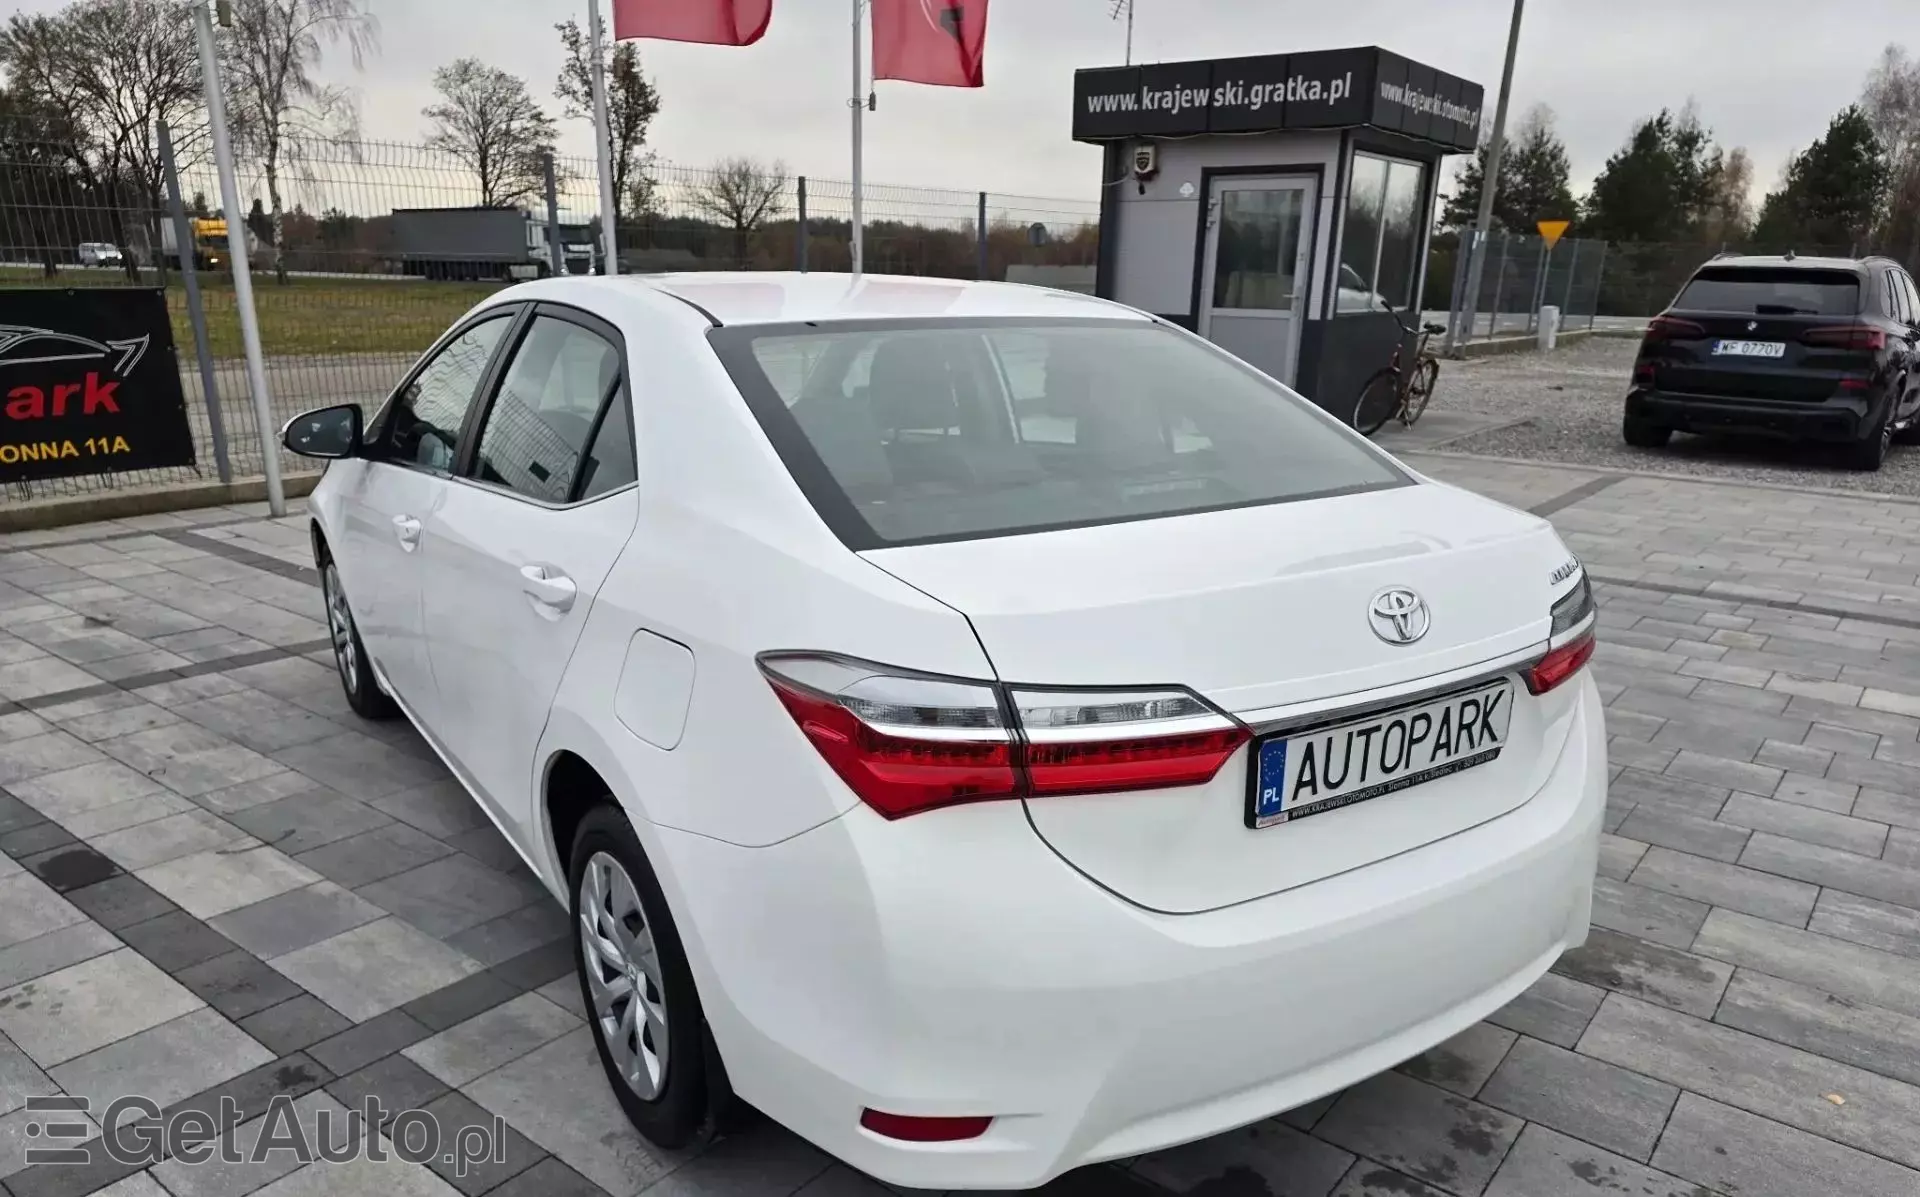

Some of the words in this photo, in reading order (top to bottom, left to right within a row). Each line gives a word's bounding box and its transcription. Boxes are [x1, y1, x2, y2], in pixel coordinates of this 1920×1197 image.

[6, 372, 120, 420] ark
[85, 436, 131, 456] 11A
[1292, 690, 1505, 801] AUTOPARK
[1263, 787, 1280, 805] PL
